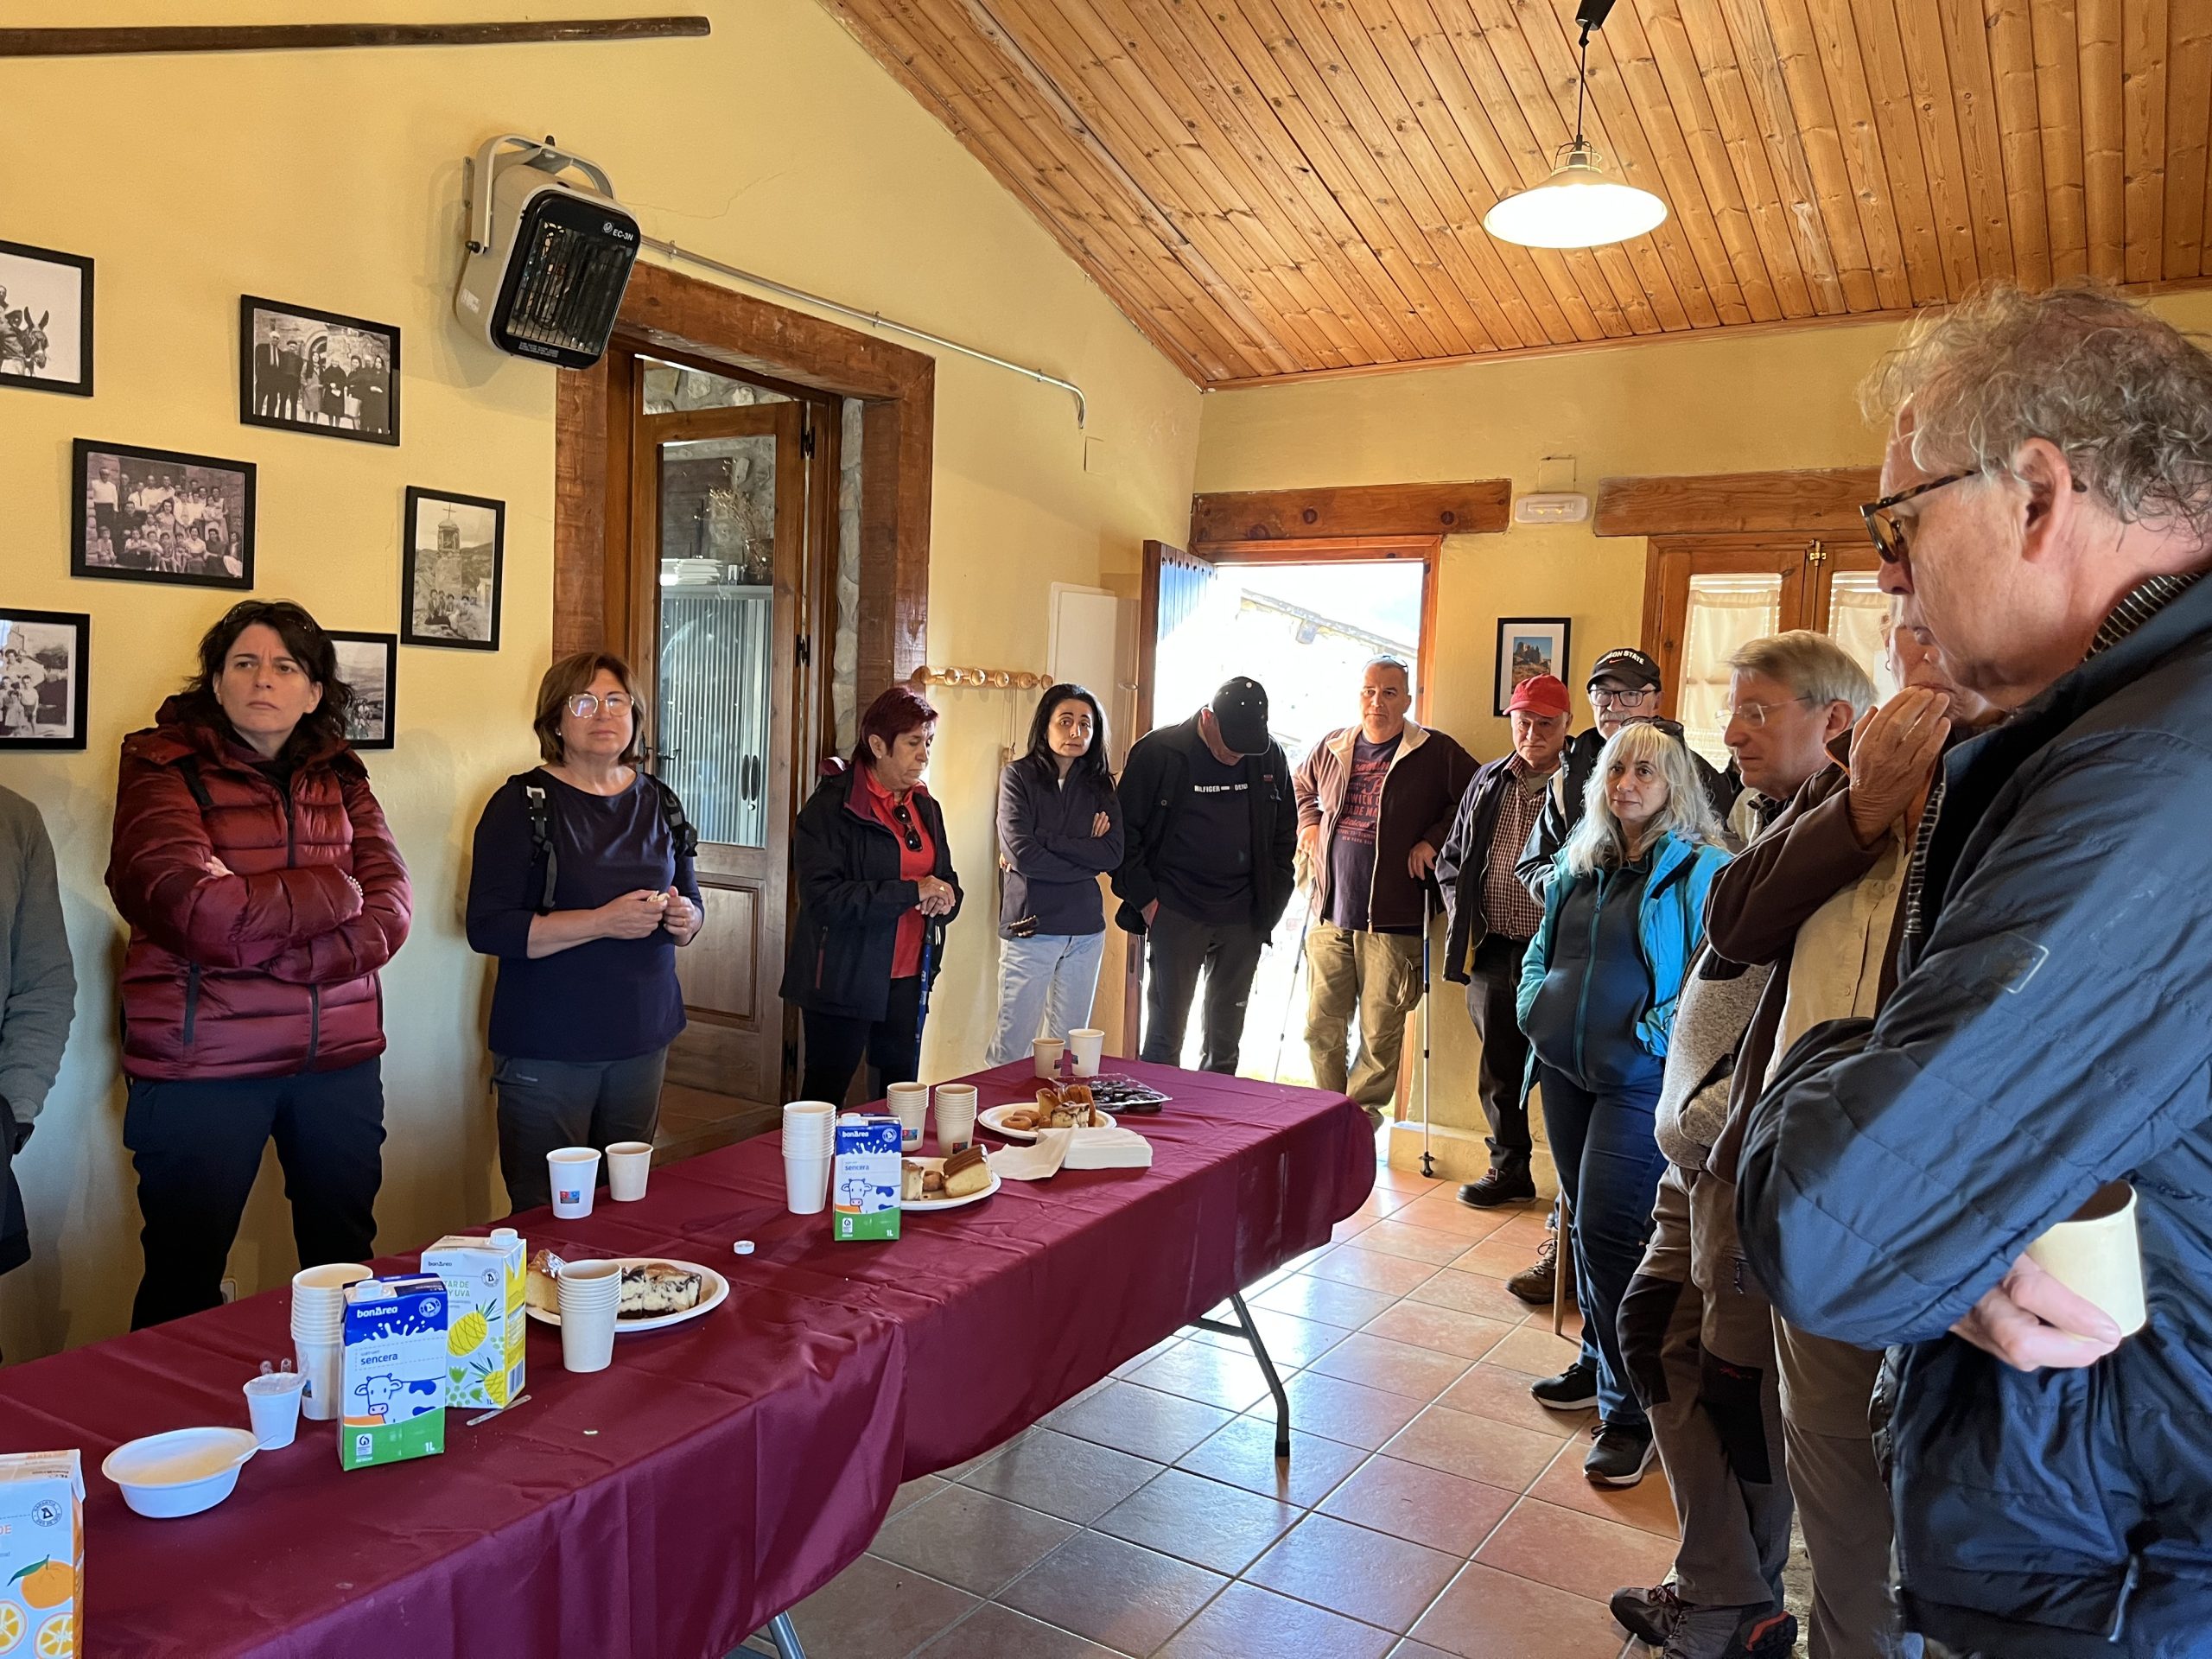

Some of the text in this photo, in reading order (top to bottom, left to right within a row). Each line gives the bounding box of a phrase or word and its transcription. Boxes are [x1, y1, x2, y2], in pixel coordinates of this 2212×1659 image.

[613, 228, 633, 241] EC-3N
[1624, 651, 1644, 664] STATE
[887, 1229, 894, 1237] 1L
[459, 1281, 470, 1289] DE
[360, 1353, 398, 1365] sencera
[424, 1441, 435, 1452] 1L
